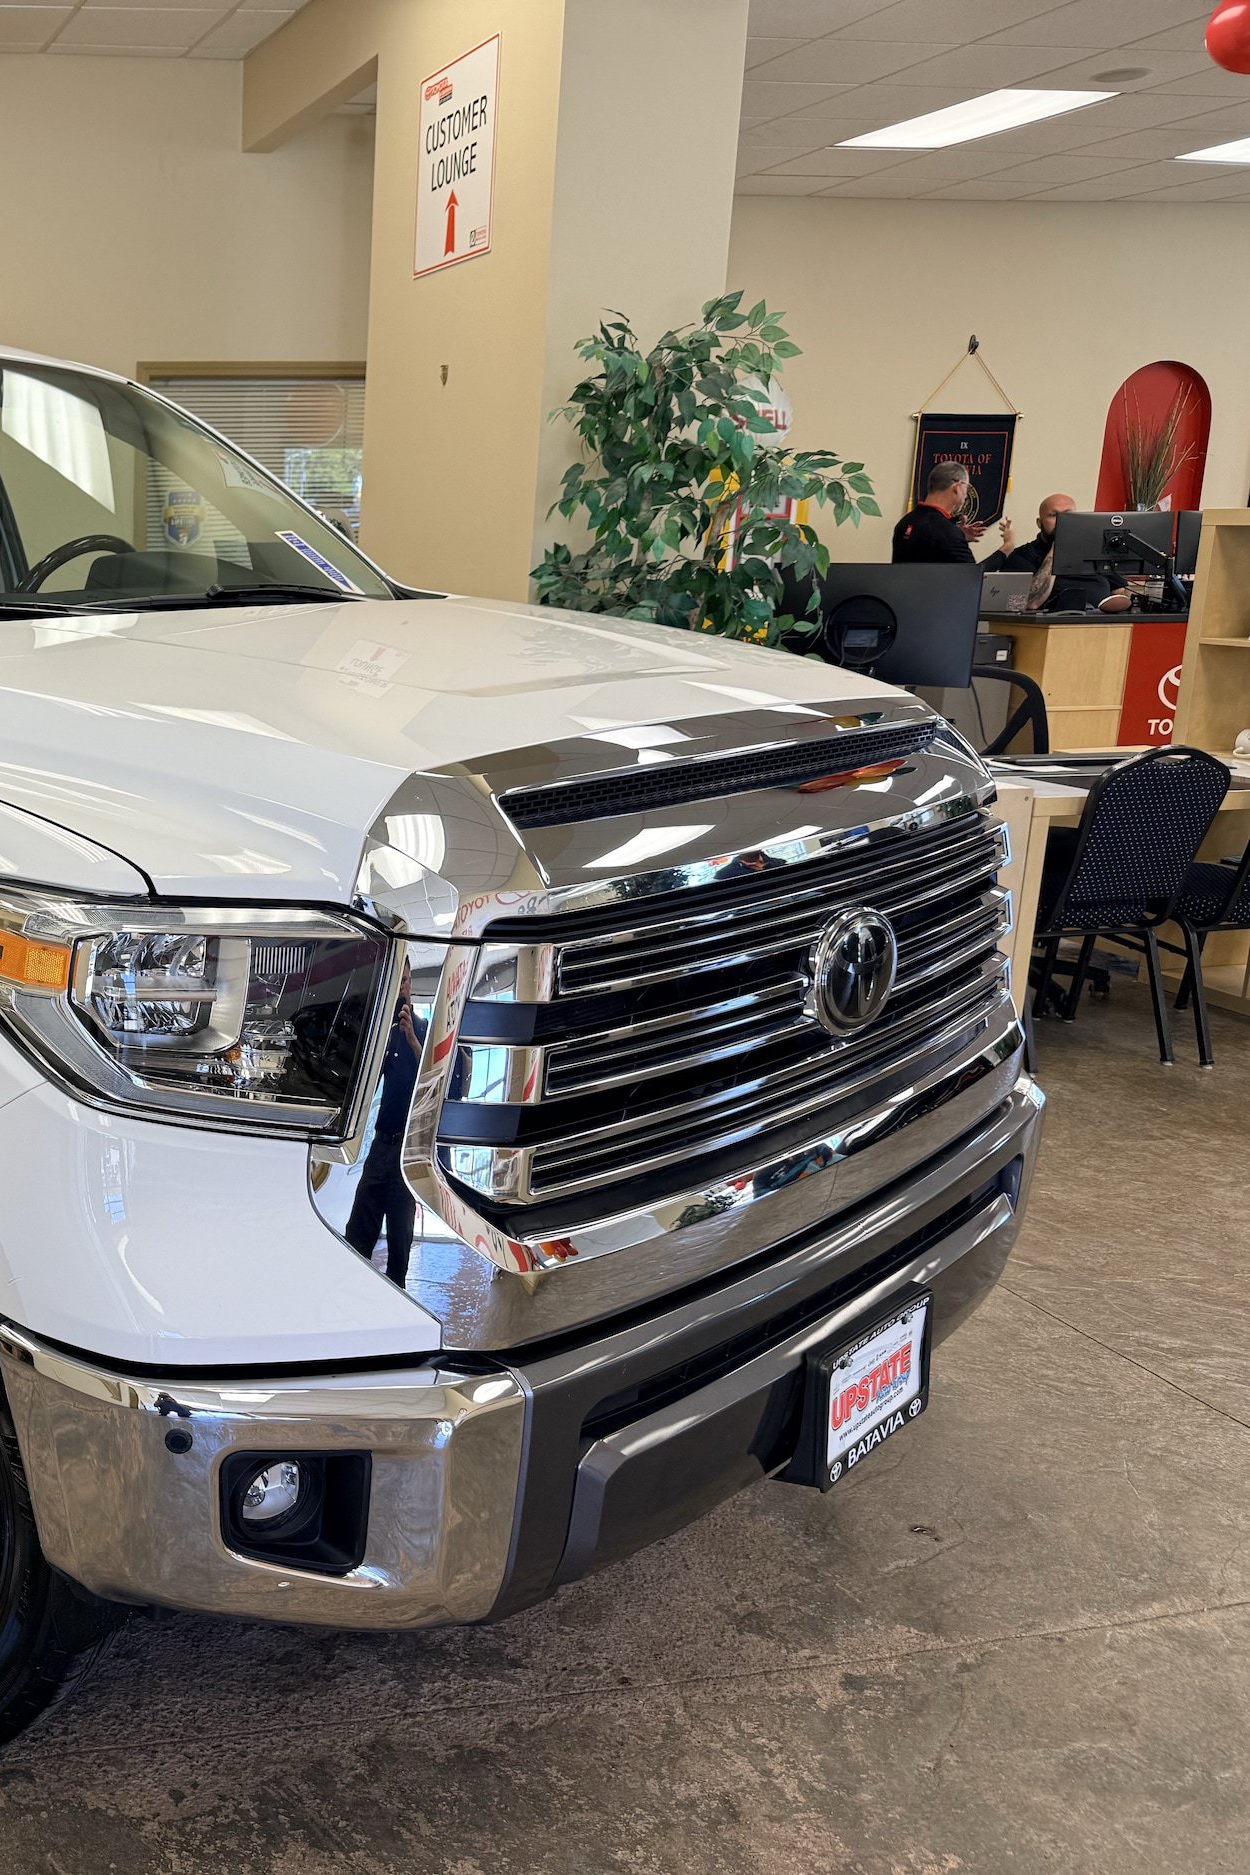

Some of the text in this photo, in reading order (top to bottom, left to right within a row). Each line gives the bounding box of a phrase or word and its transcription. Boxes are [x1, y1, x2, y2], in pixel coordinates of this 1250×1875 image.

[425, 95, 488, 155] CUSTOMER
[431, 142, 478, 192] LOUNGE
[933, 453, 992, 465] TOYOTA OF
[869, 1318, 896, 1340] AUTO
[831, 1340, 912, 1431] UPSTATE
[847, 1410, 905, 1469] BATAVIA
